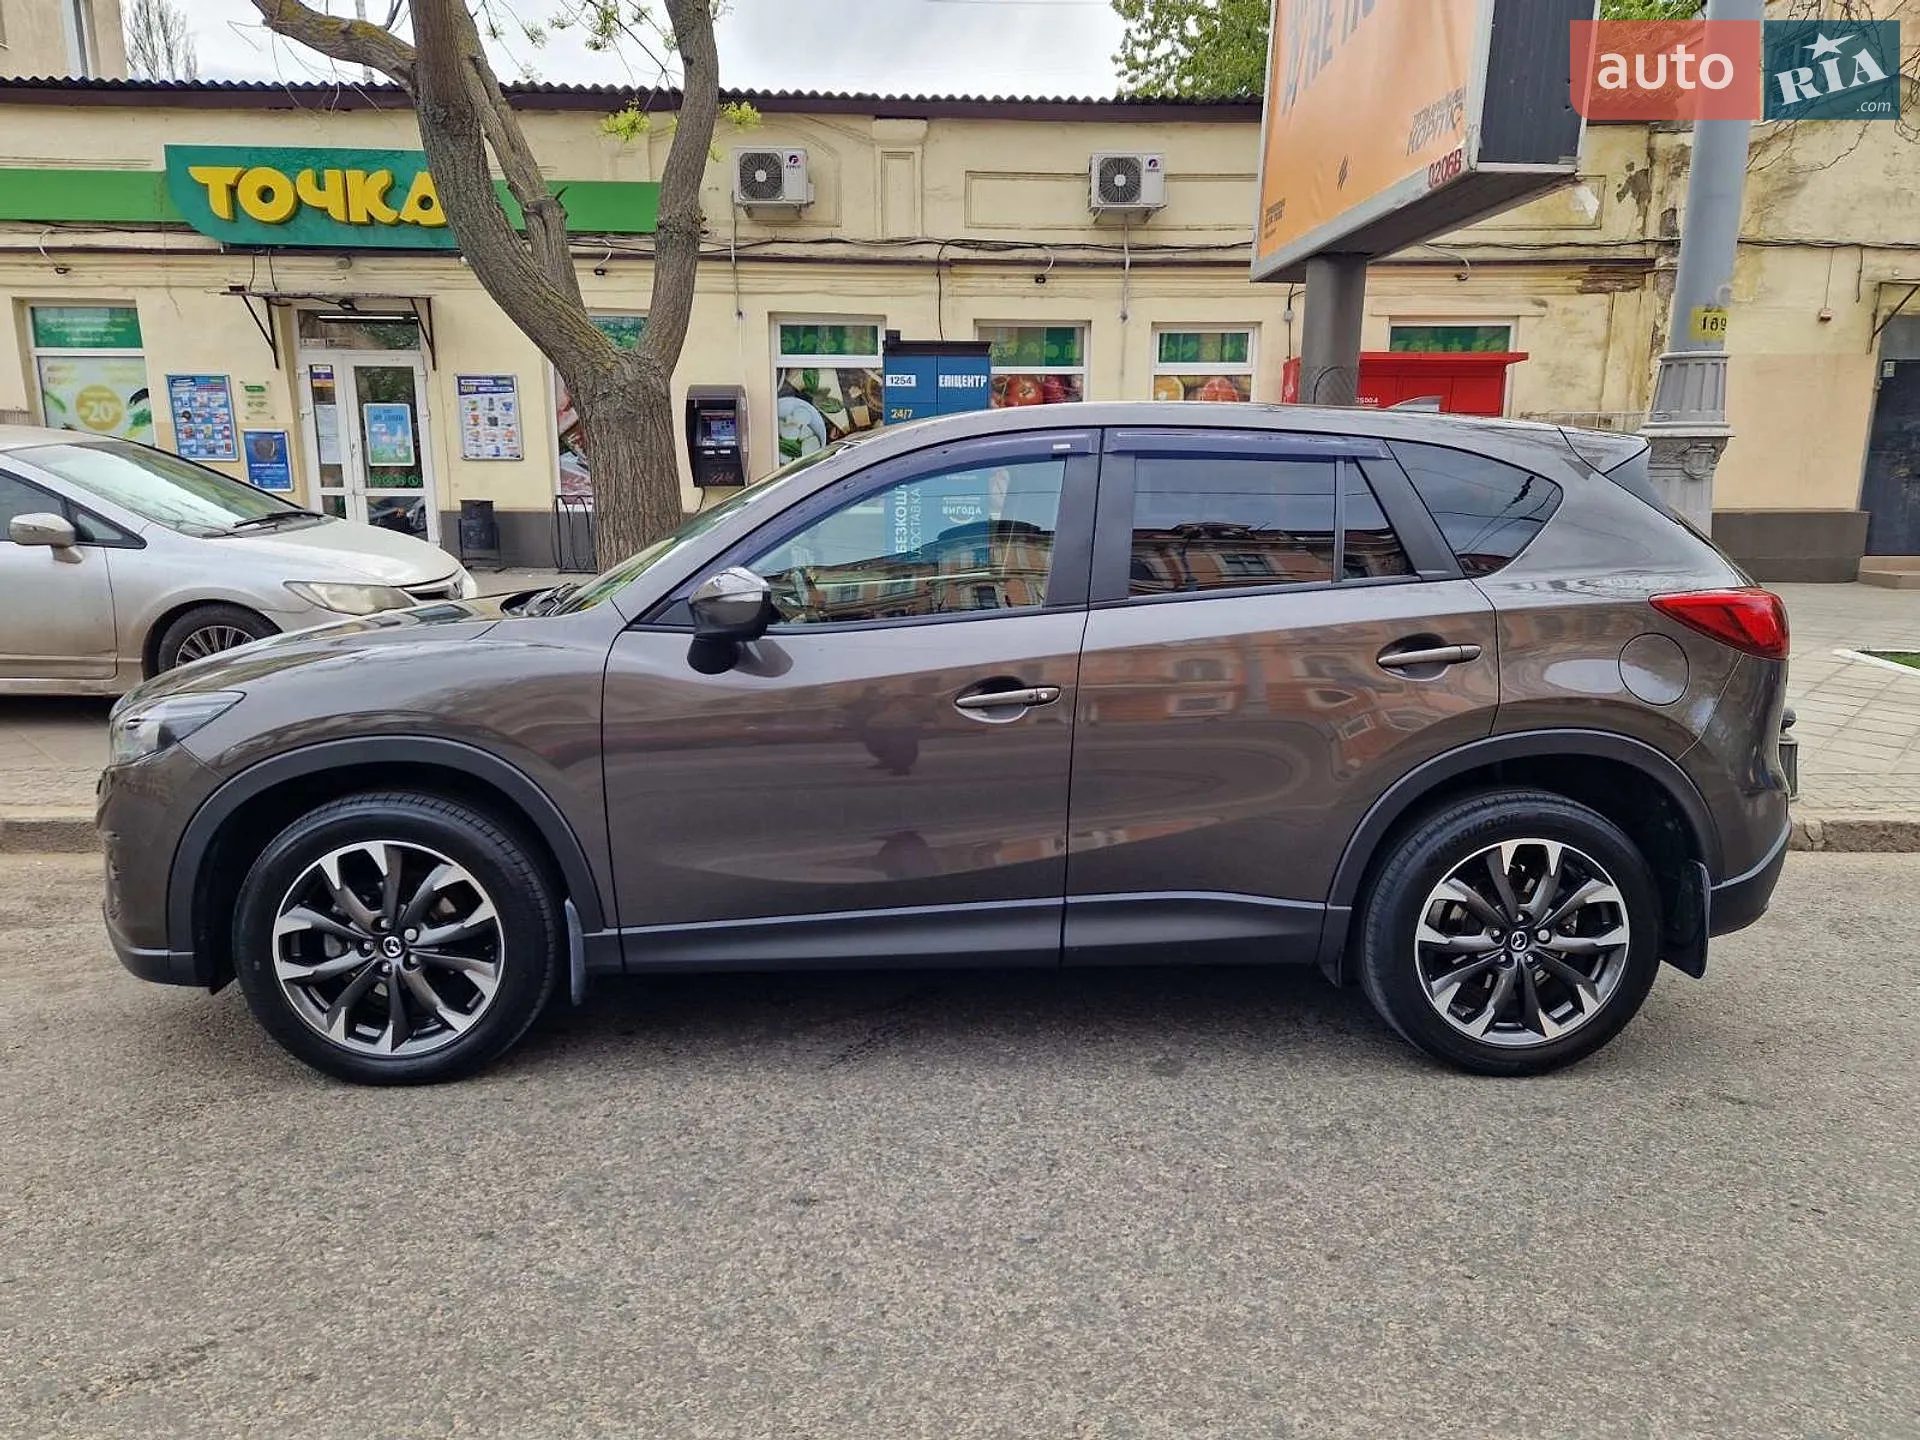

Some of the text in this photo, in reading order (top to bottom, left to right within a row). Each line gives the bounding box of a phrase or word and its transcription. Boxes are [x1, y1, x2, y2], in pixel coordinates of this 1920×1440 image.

[188, 166, 447, 227] ТОЧКА
[889, 376, 913, 385] 1254
[938, 374, 988, 388] ЕПІЦЕНТР
[890, 408, 913, 420] 24/7
